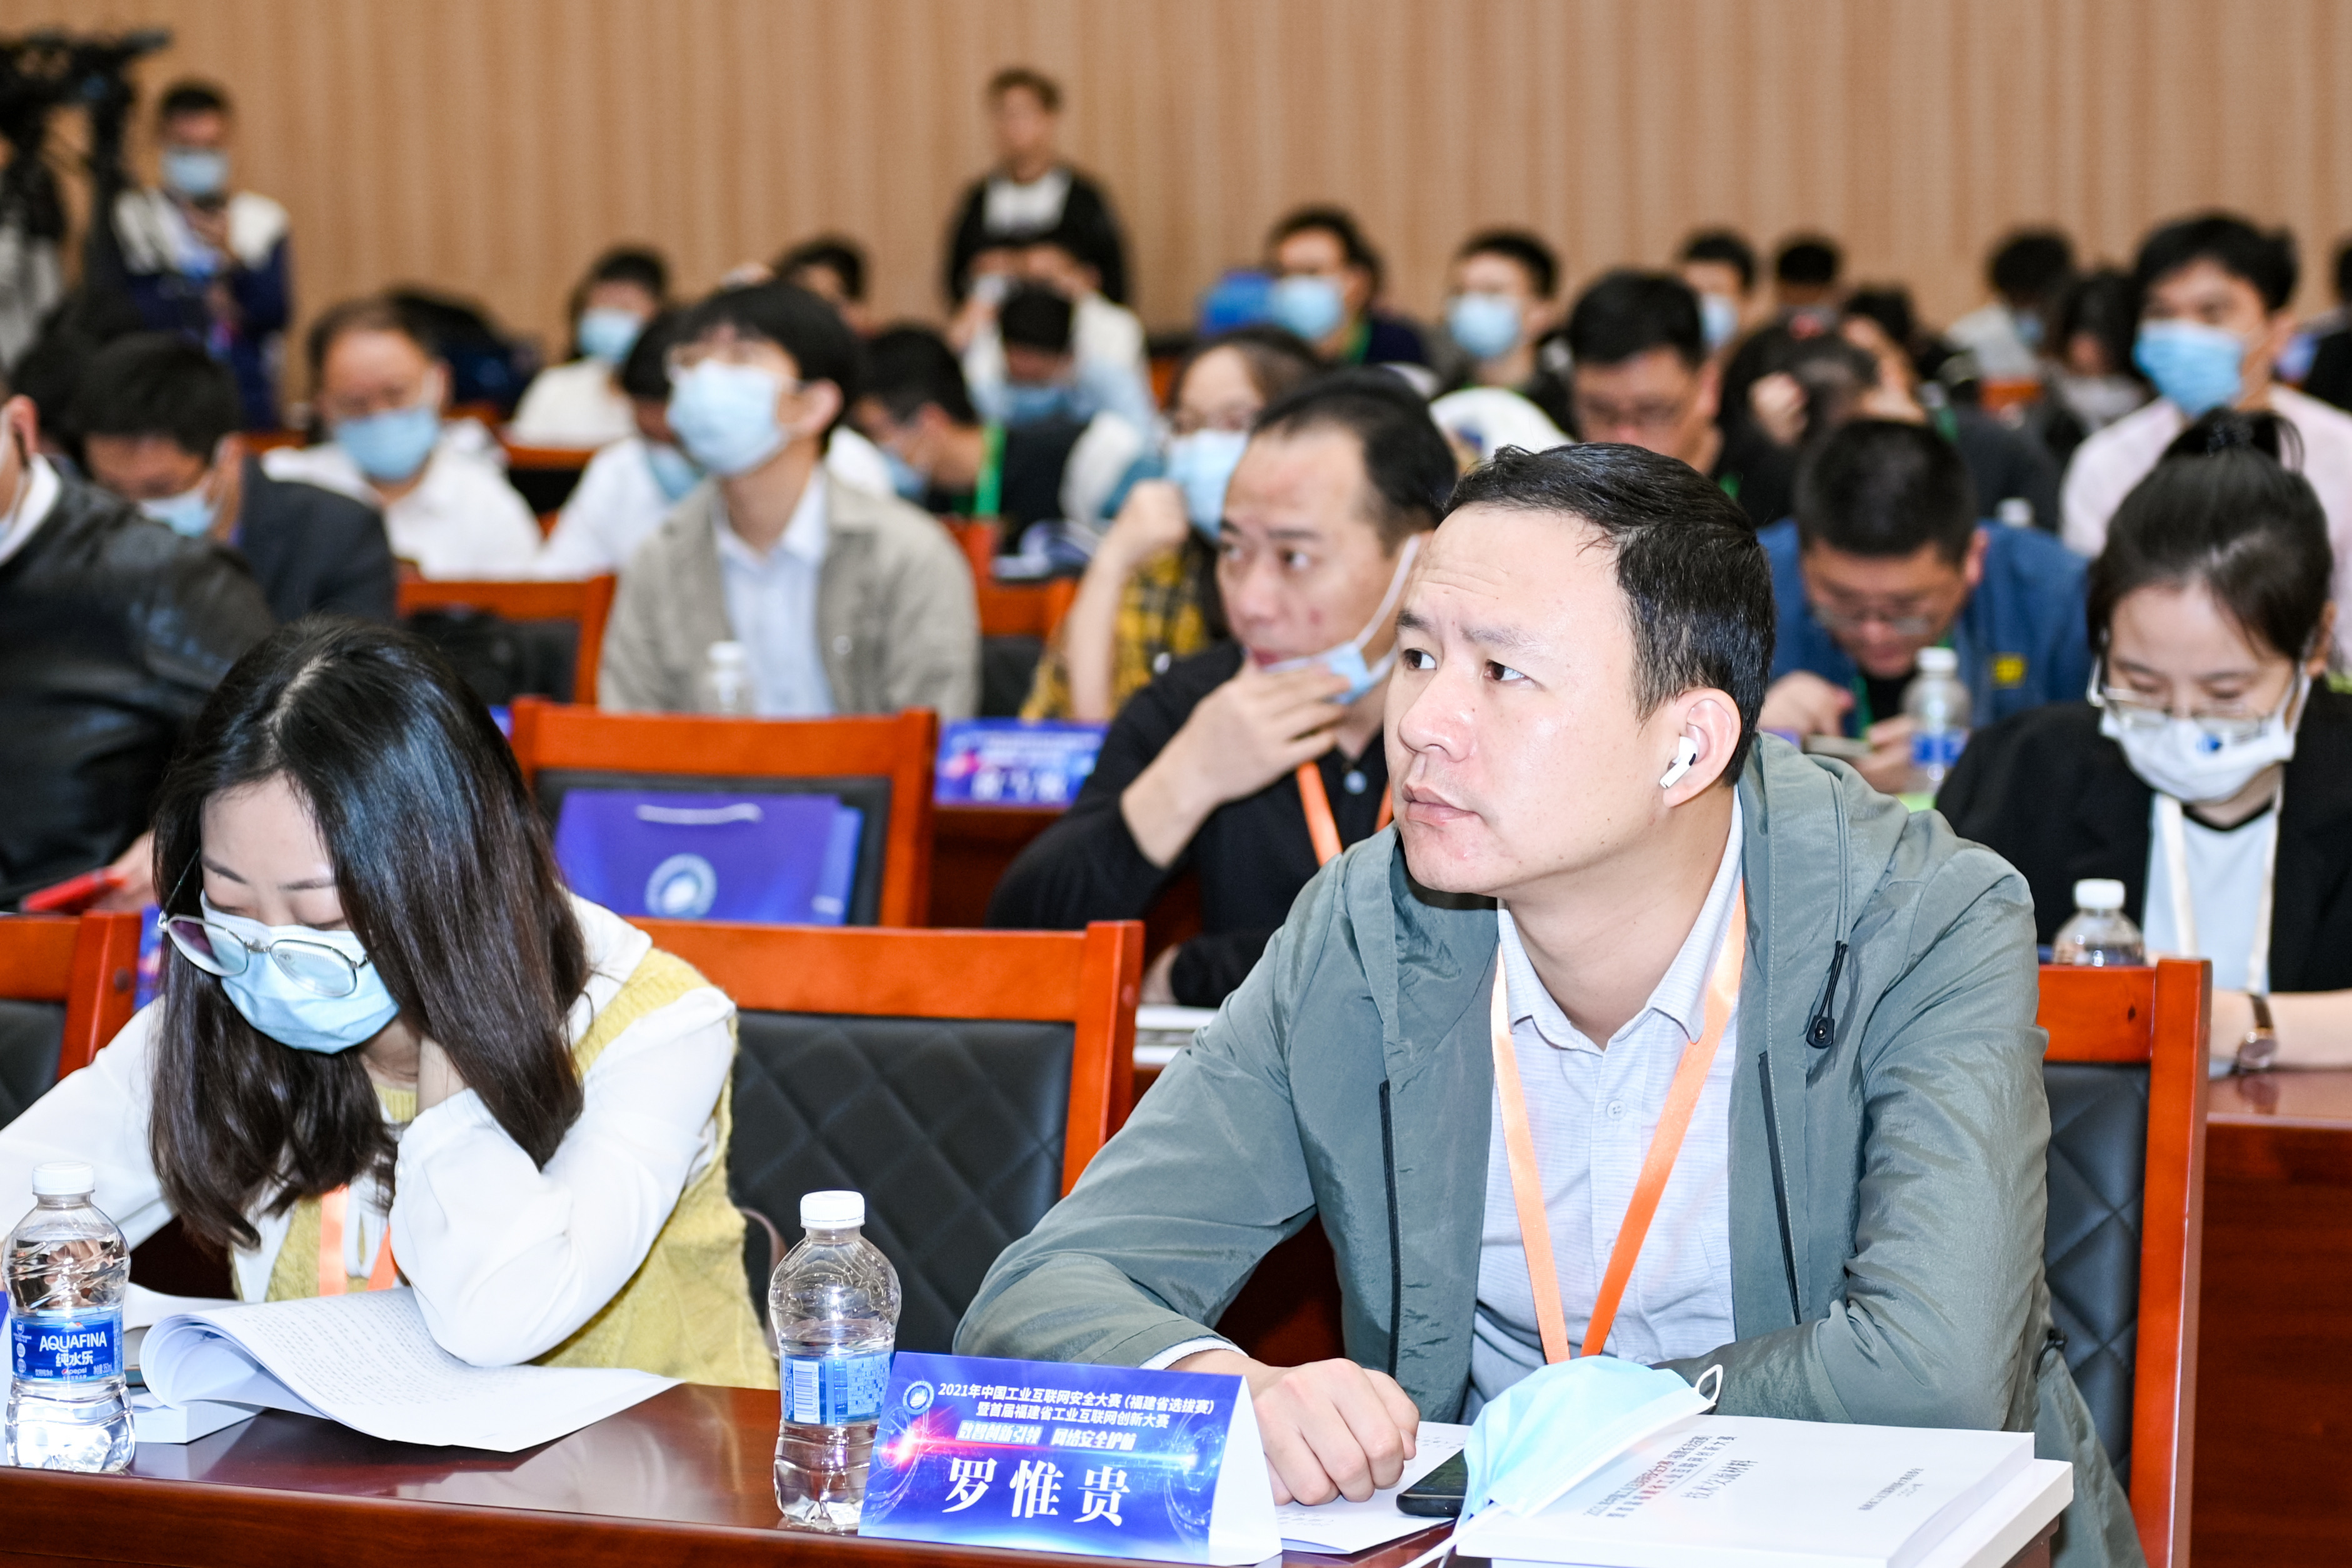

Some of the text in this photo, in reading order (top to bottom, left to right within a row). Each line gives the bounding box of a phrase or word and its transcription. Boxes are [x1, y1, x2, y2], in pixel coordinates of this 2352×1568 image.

[39, 1331, 108, 1352] AQUAFINA
[56, 1351, 93, 1367] 纯水乐
[69, 1367, 87, 1376] pepsi
[976, 1402, 1170, 1429] 暨首届福建省工业互联网创新大赛
[958, 1422, 1137, 1451] 数智创新引领 网络安全护航
[942, 1457, 1131, 1527] 罗惟贵
